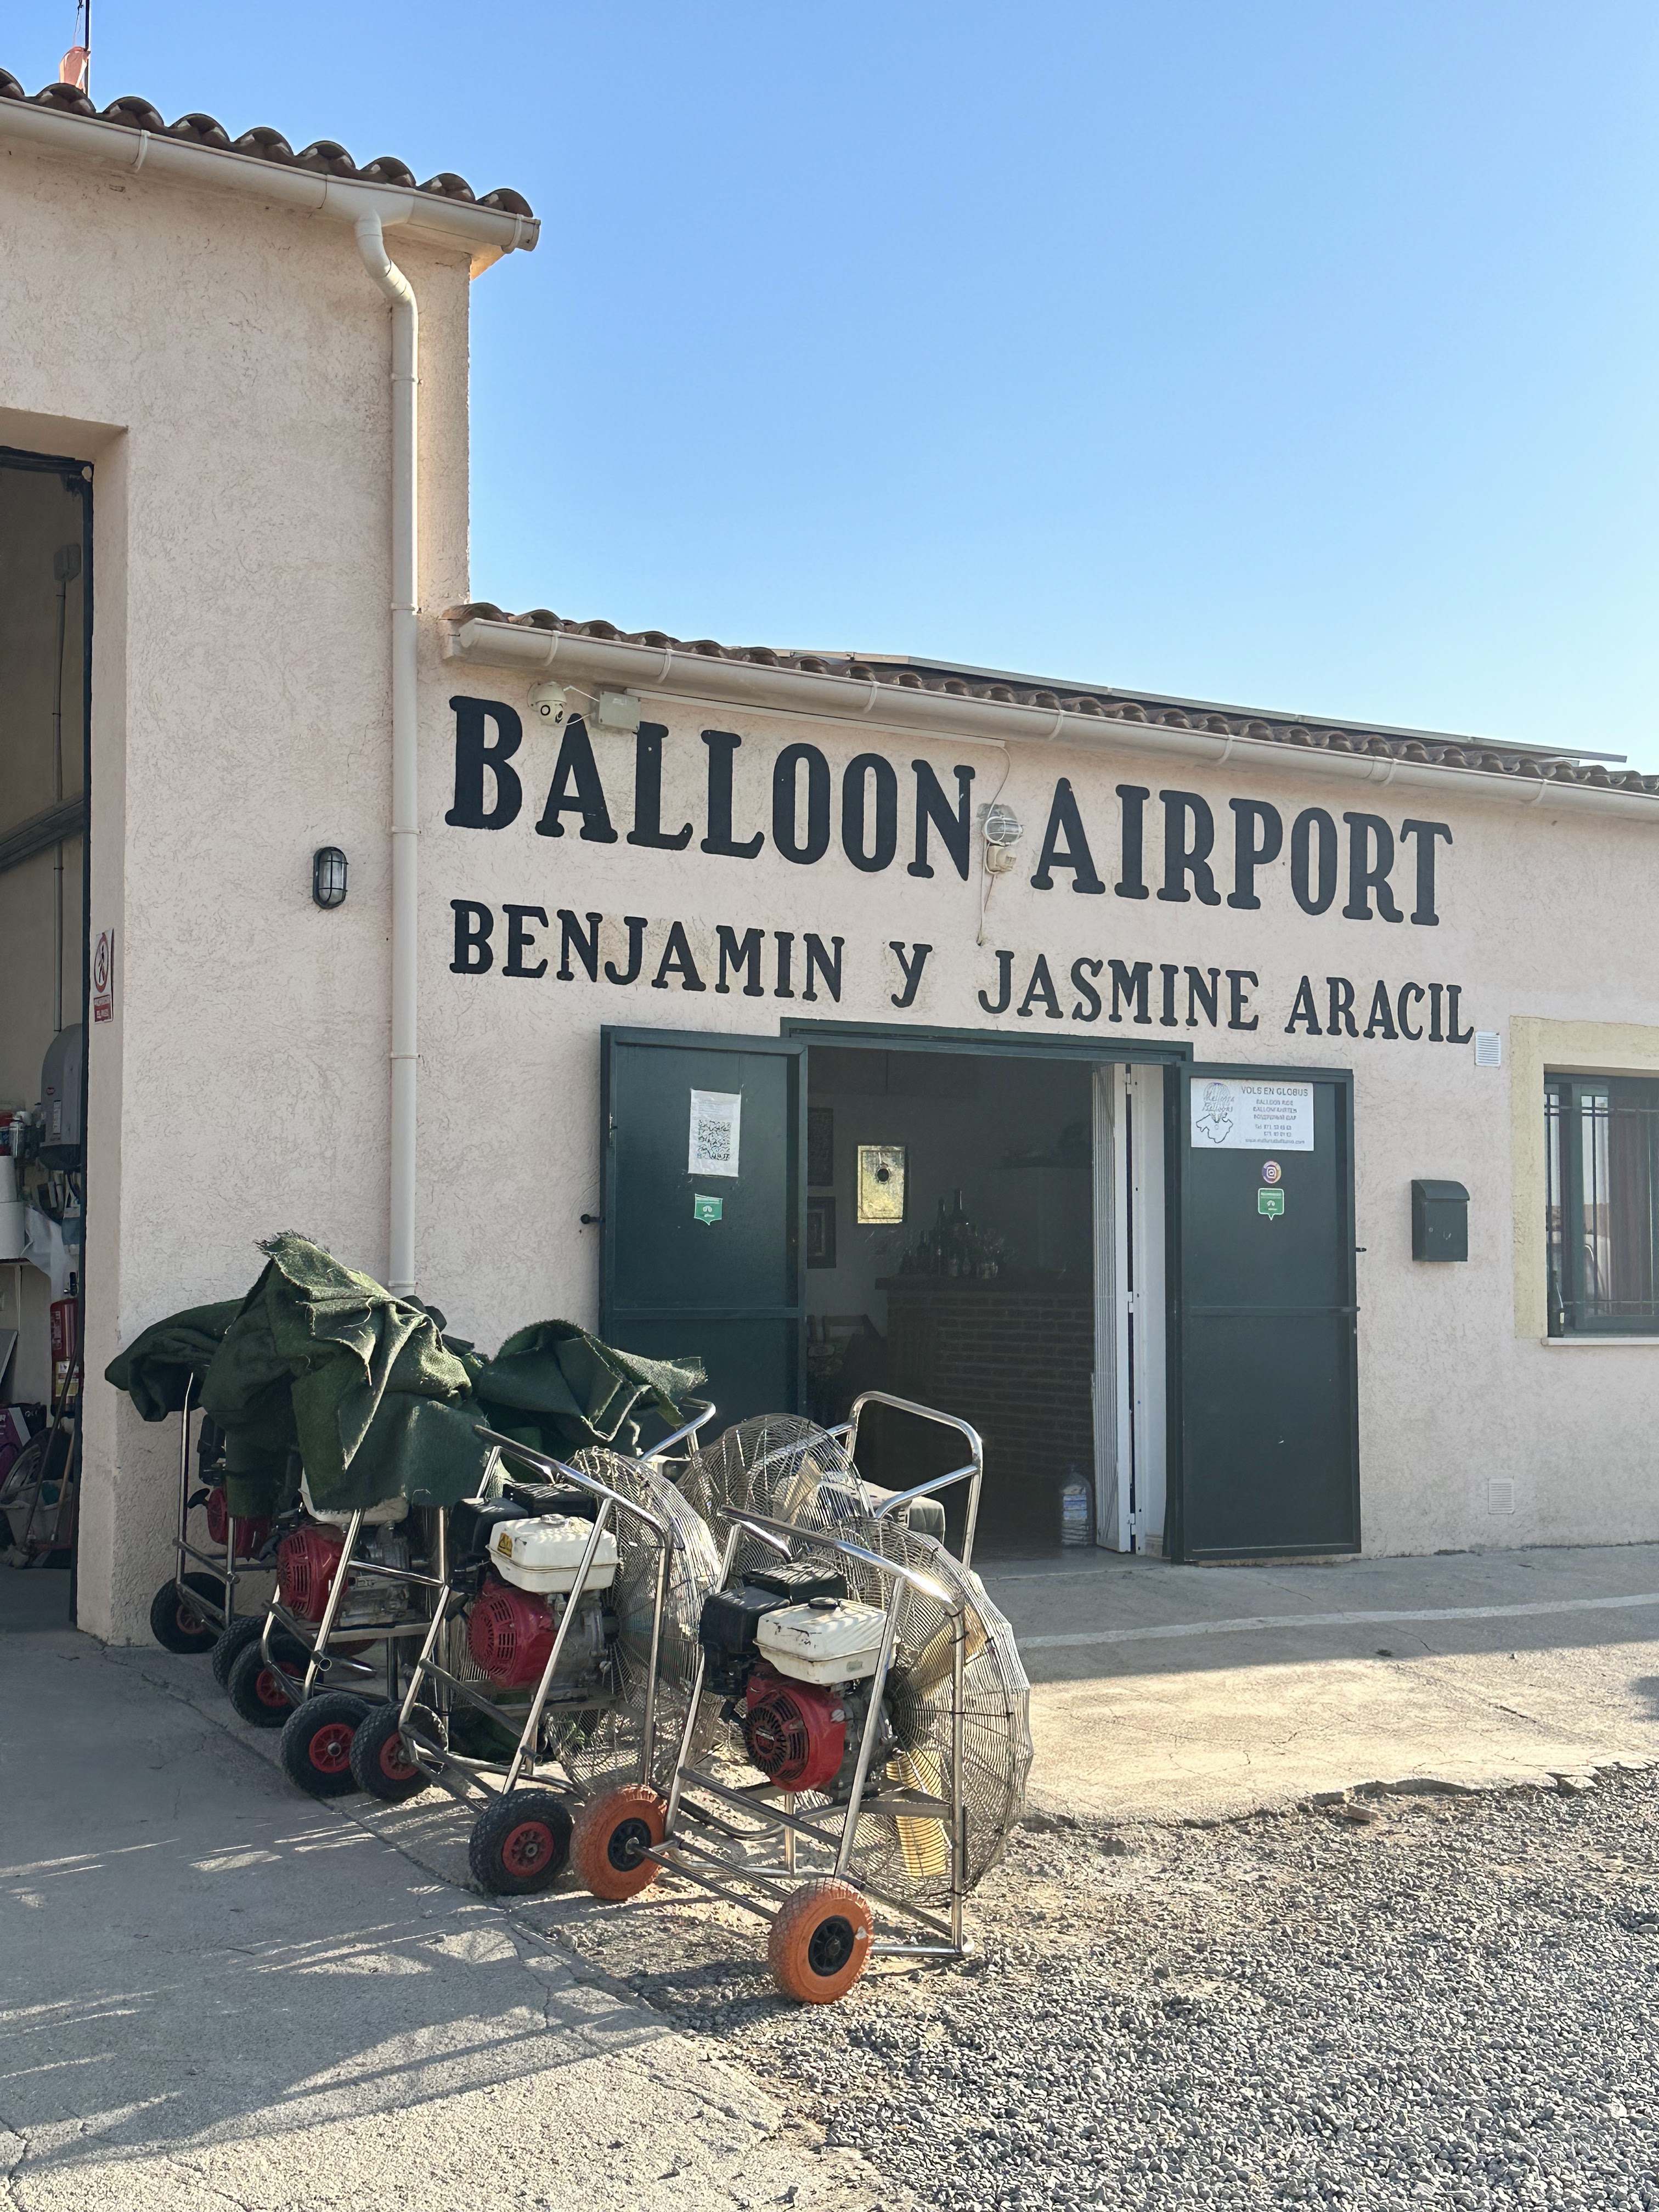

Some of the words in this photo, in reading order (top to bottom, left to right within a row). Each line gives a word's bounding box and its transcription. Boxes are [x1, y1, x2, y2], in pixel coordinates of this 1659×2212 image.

[445, 696, 975, 881] BALLOON
[1030, 778, 1452, 926] AIRPORT
[450, 900, 844, 1002] BENJAMIN
[978, 950, 1259, 1030] JASMINE
[1285, 976, 1474, 1043] ARACIL
[1241, 1086, 1262, 1094] VOLS
[1276, 1088, 1308, 1096] GLOBUS
